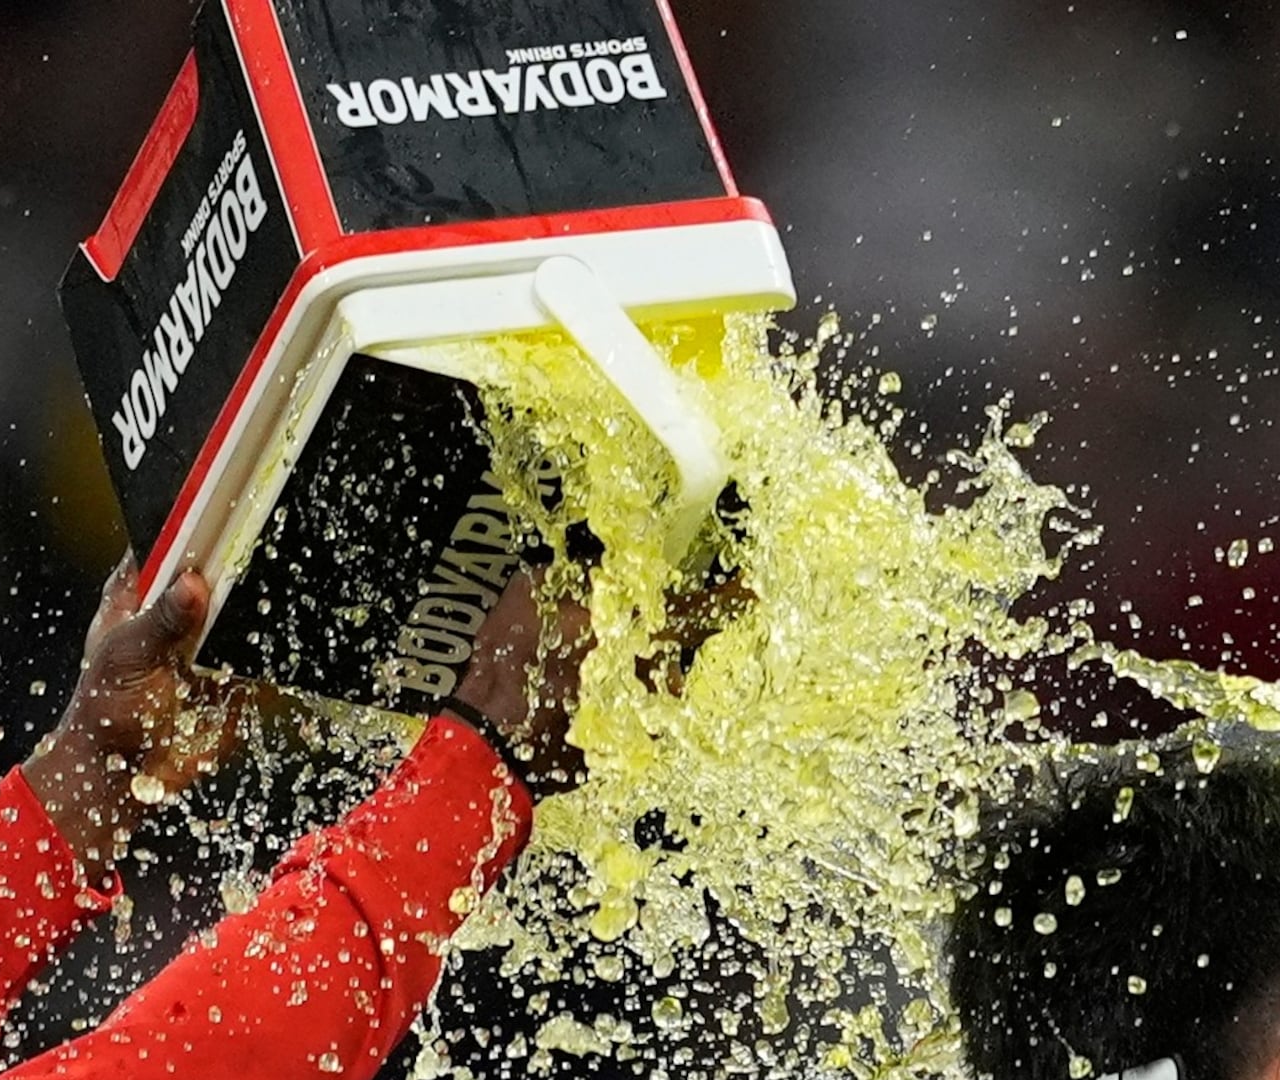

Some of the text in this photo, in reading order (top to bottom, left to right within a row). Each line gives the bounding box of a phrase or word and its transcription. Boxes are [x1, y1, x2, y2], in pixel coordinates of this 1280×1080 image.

[326, 53, 668, 128] BODYARMOR
[506, 36, 648, 64] SPORTS DRINK
[180, 129, 247, 259] SPORTS DRINK
[111, 152, 268, 471] BODYARMOR
[383, 451, 561, 698] BODYARM
